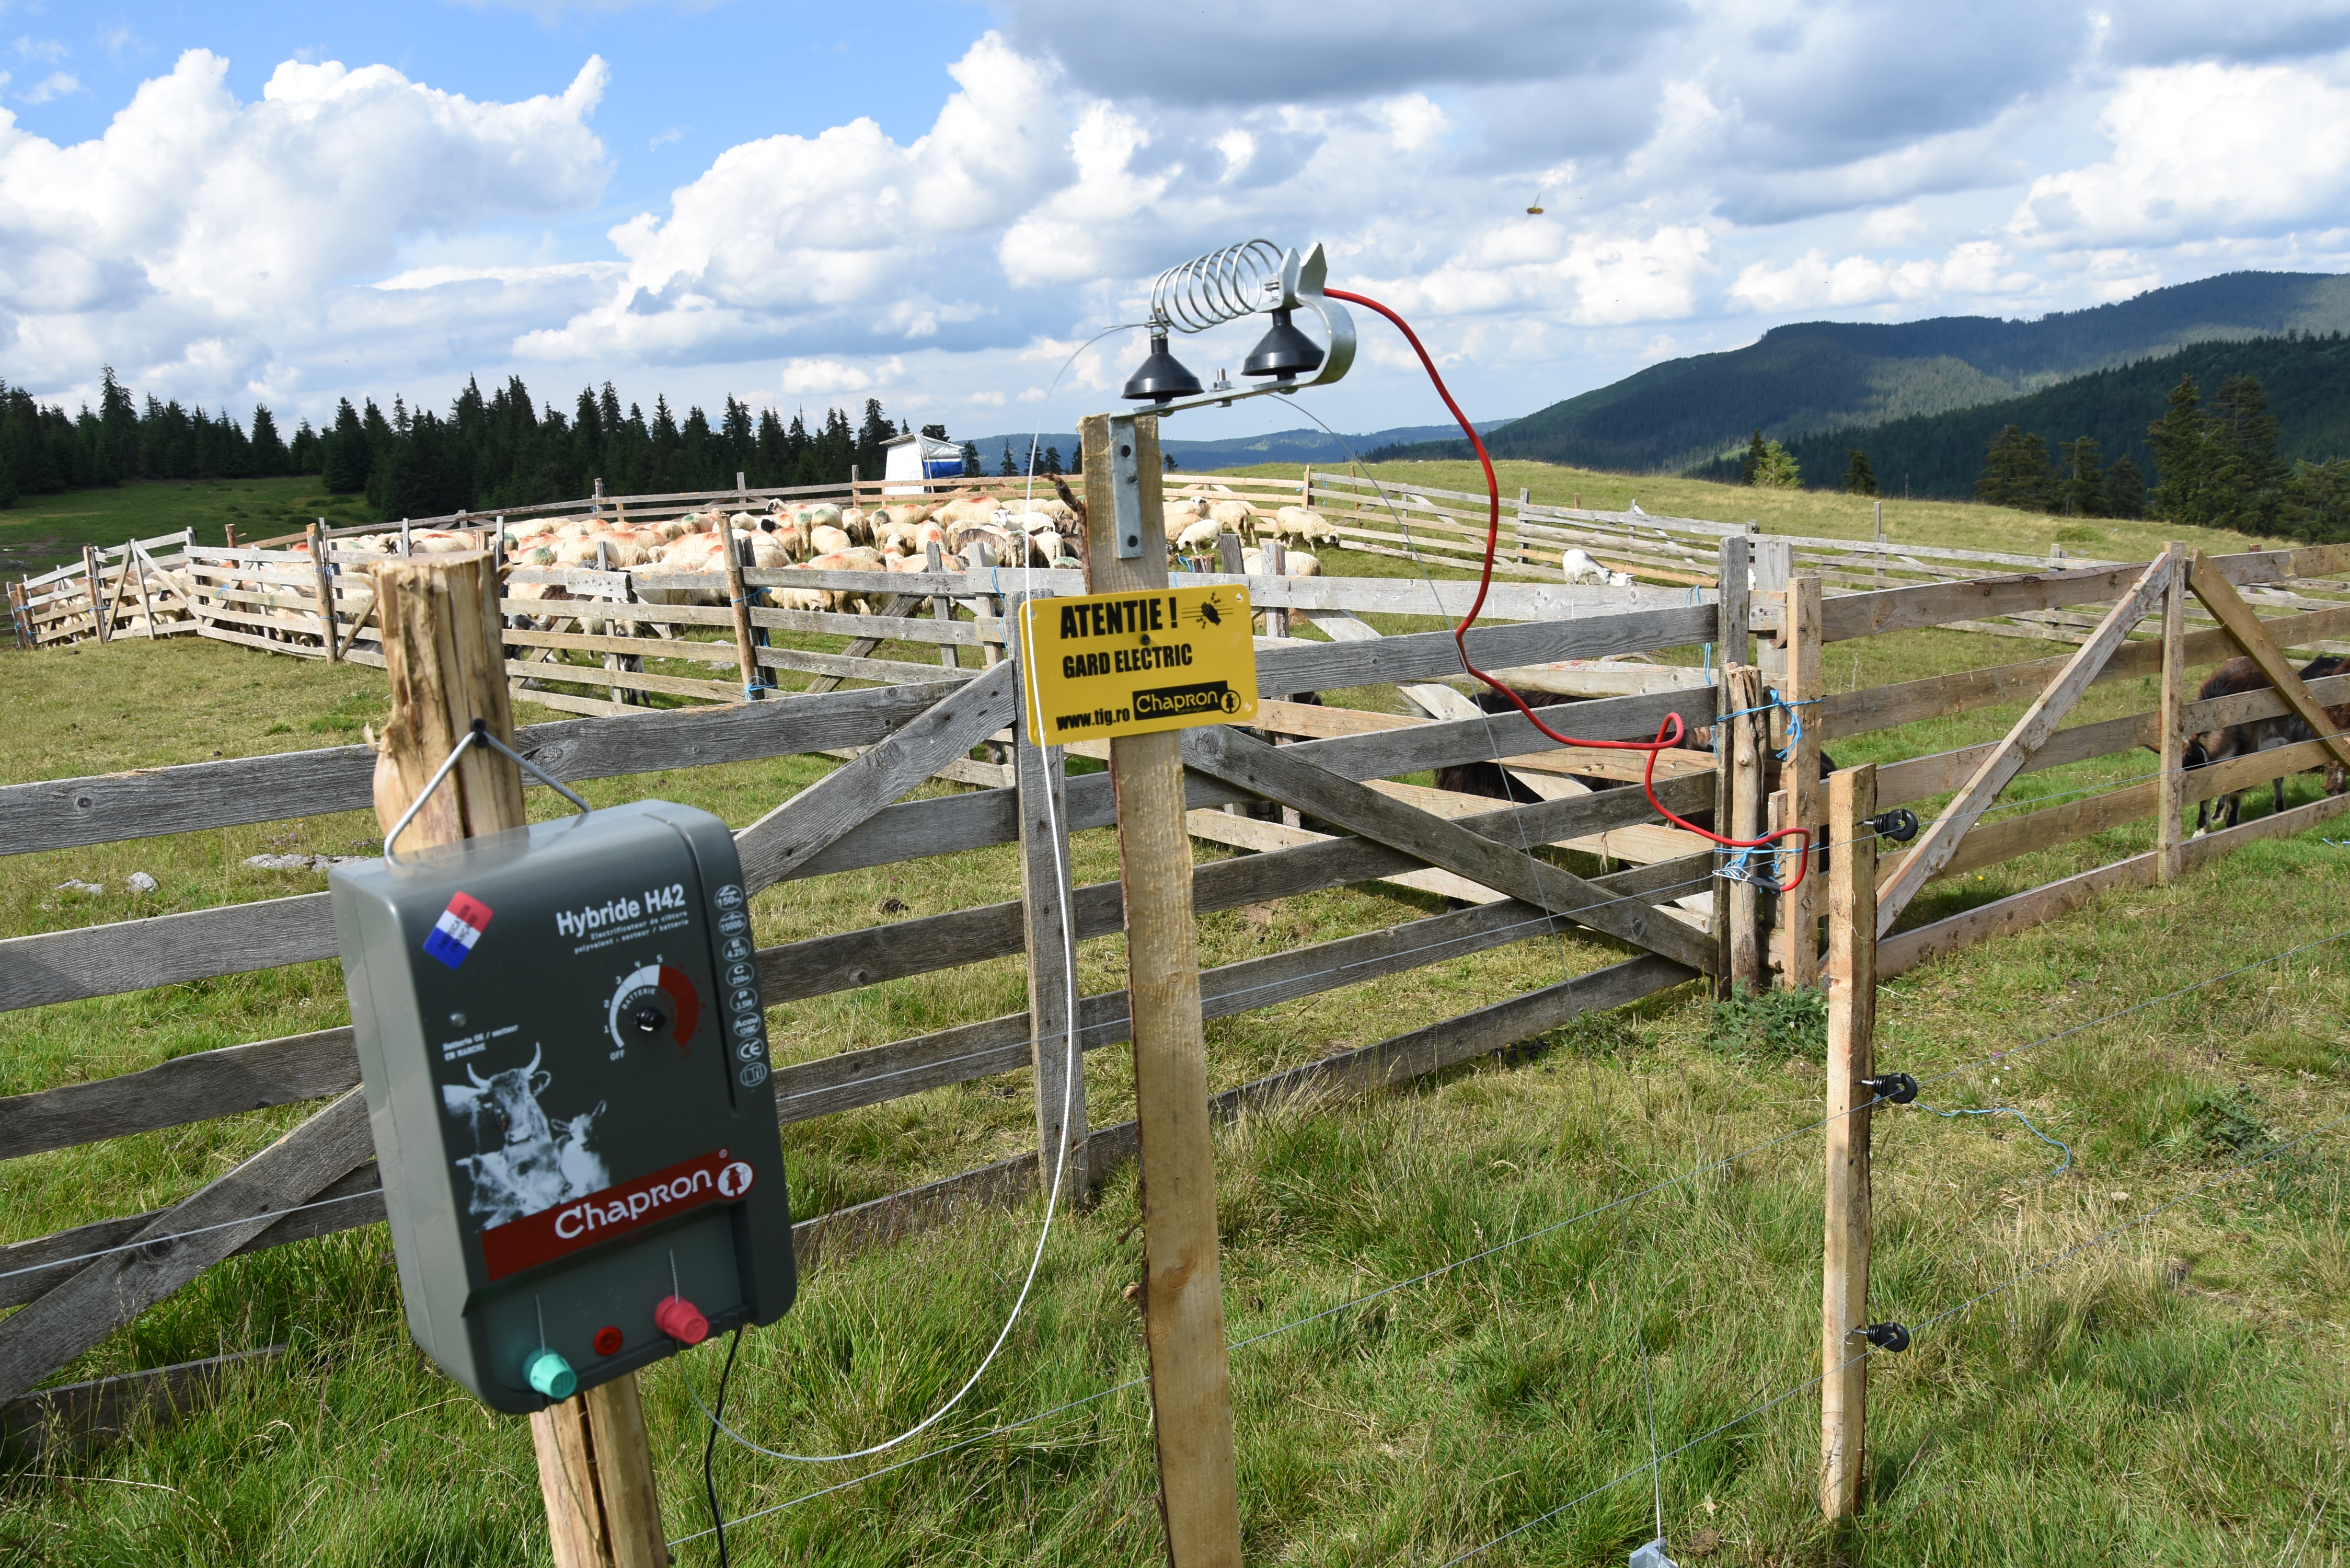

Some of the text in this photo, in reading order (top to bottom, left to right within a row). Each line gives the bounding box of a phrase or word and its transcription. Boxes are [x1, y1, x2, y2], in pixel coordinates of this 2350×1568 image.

[1061, 597, 1178, 639] ATENTIE !
[1063, 643, 1192, 678] GARD ELECTRIC
[1136, 691, 1218, 713] Chapron
[1056, 708, 1130, 731] www.tig.ro
[556, 883, 686, 938] Hybride H42
[656, 954, 663, 963] 5
[733, 965, 745, 975] C
[604, 999, 610, 1008] 2
[621, 988, 656, 1010] BATTERIE
[738, 990, 748, 999] P
[604, 1025, 609, 1034] 1
[609, 1049, 625, 1061] OFF
[555, 1170, 712, 1239] Chapron
